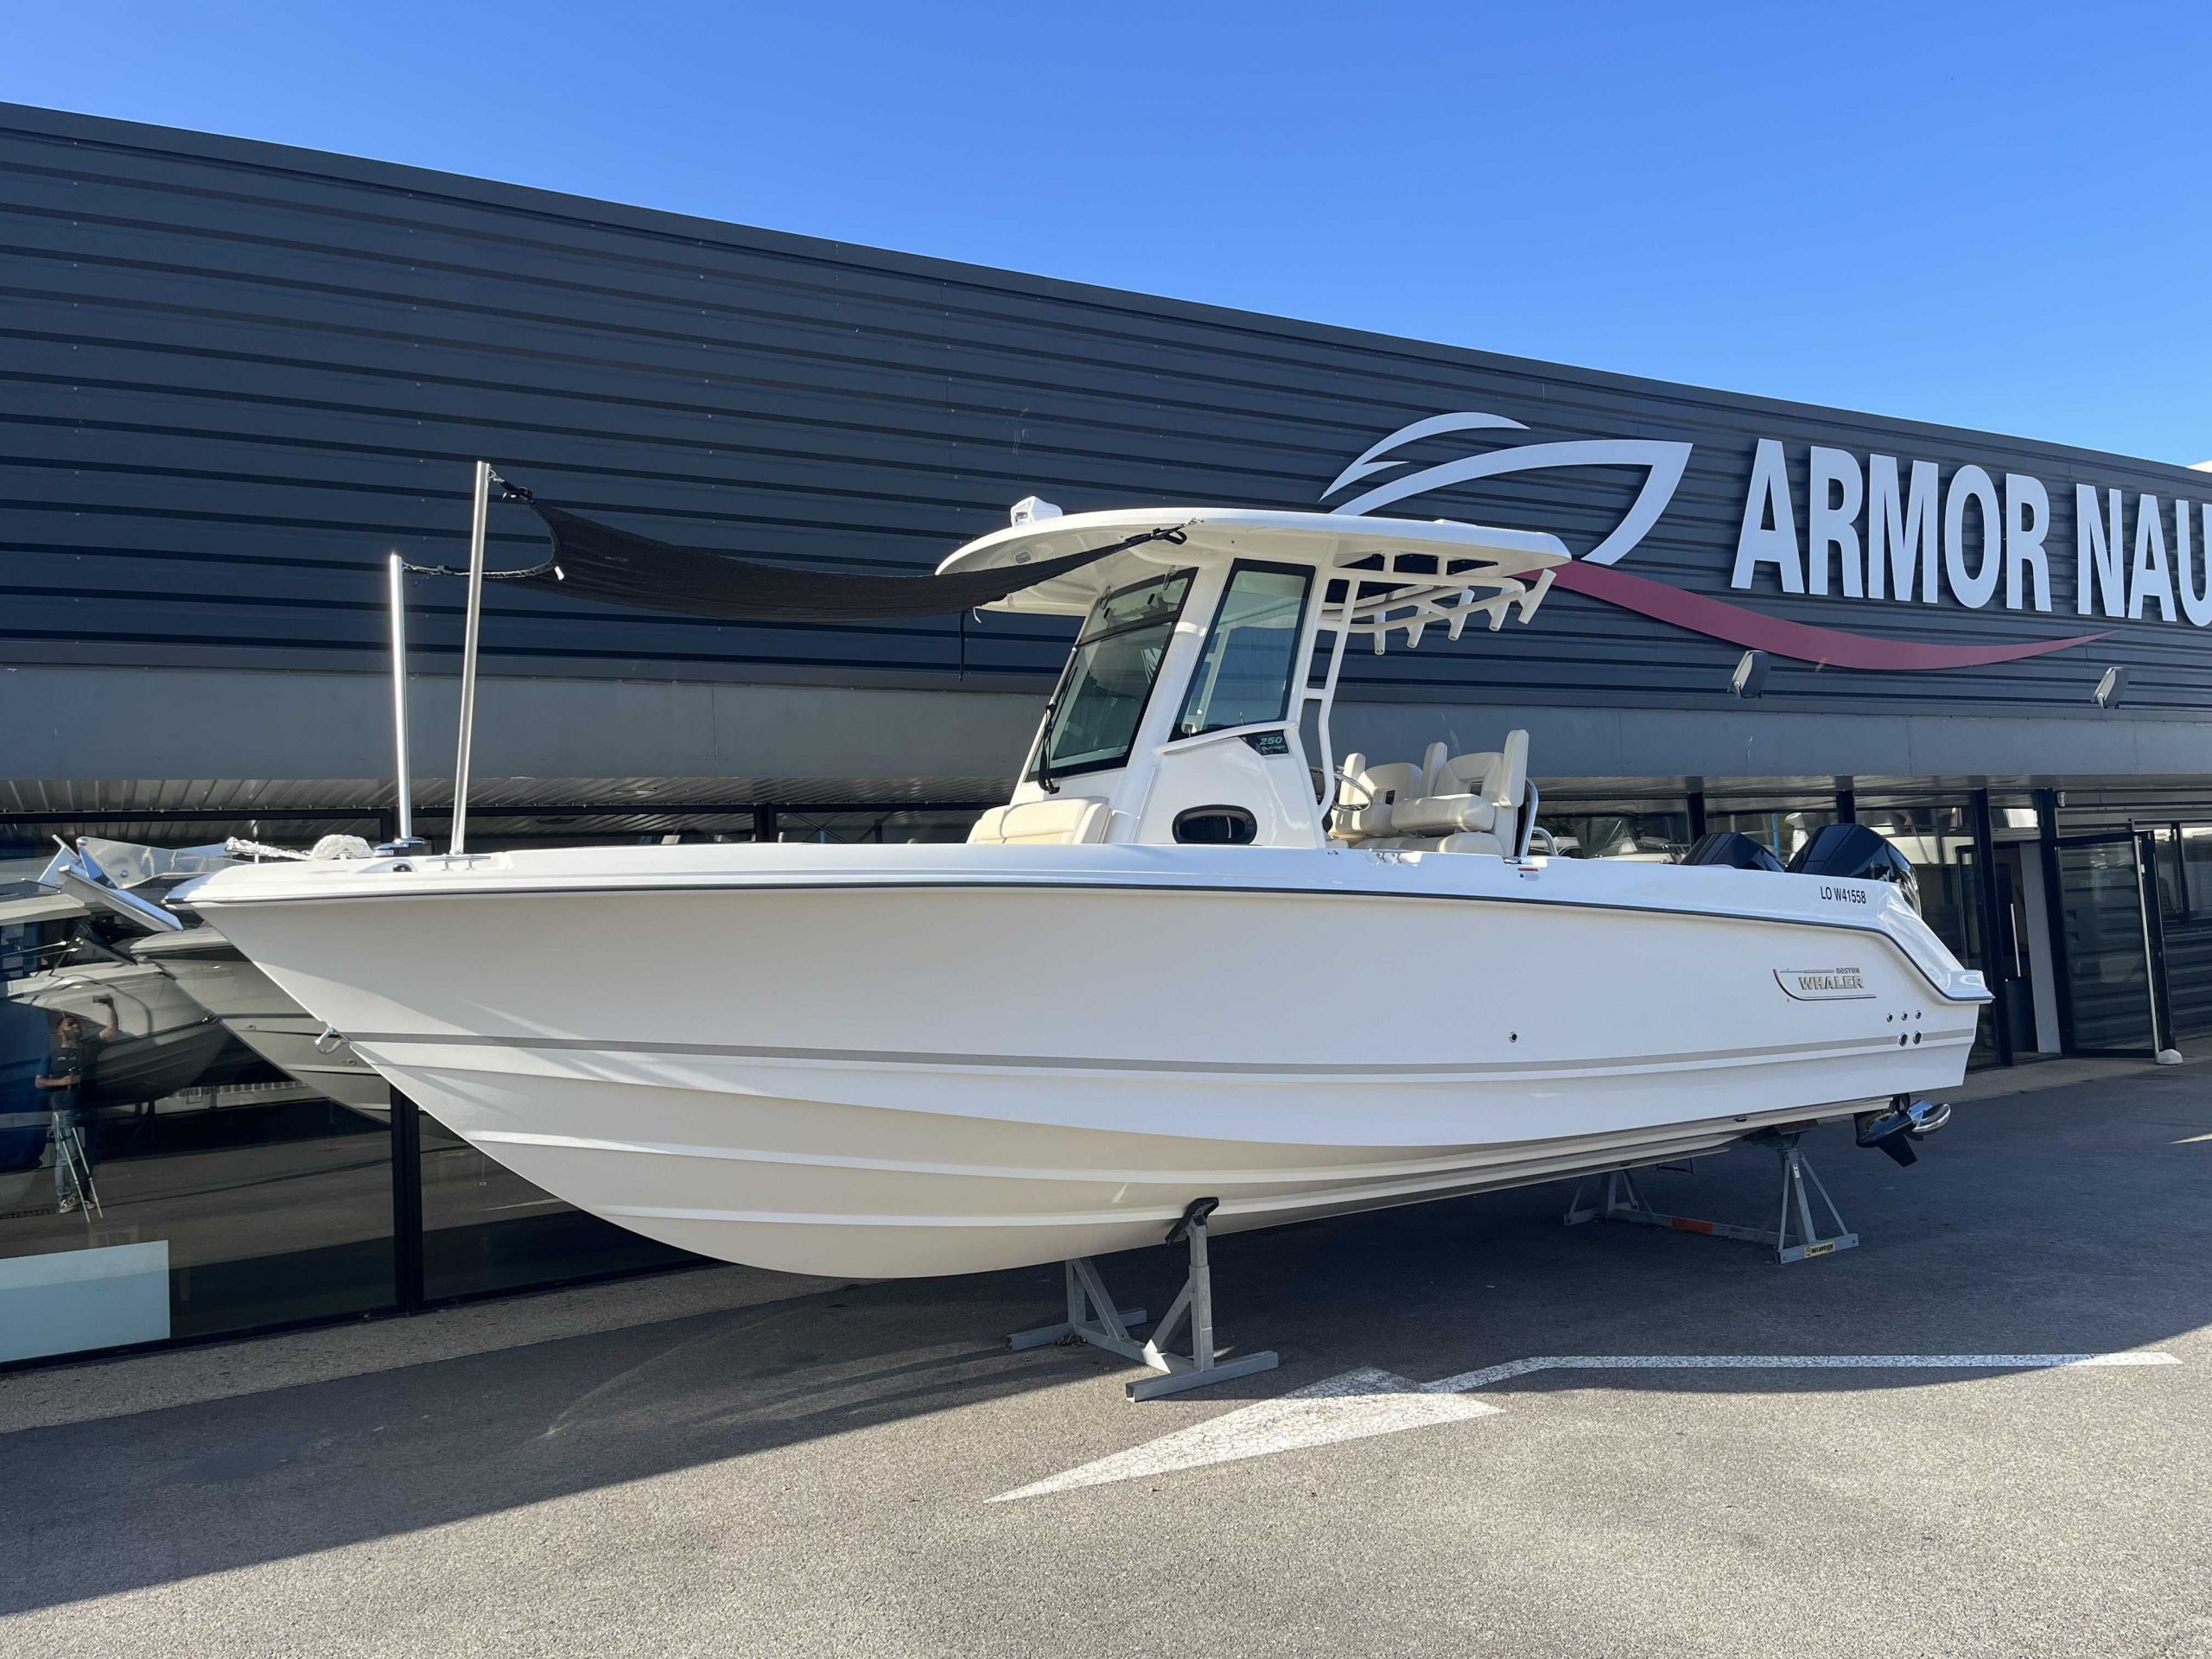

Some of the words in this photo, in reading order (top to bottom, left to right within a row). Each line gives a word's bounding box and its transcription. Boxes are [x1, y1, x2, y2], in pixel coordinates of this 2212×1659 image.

[1731, 438, 2052, 612] ARMOR
[2075, 483, 2212, 626] NAU
[1260, 736, 1283, 746] 250
[1820, 886, 1833, 900] LO
[1834, 887, 1866, 904] W41558
[1798, 976, 1865, 990] WHALER
